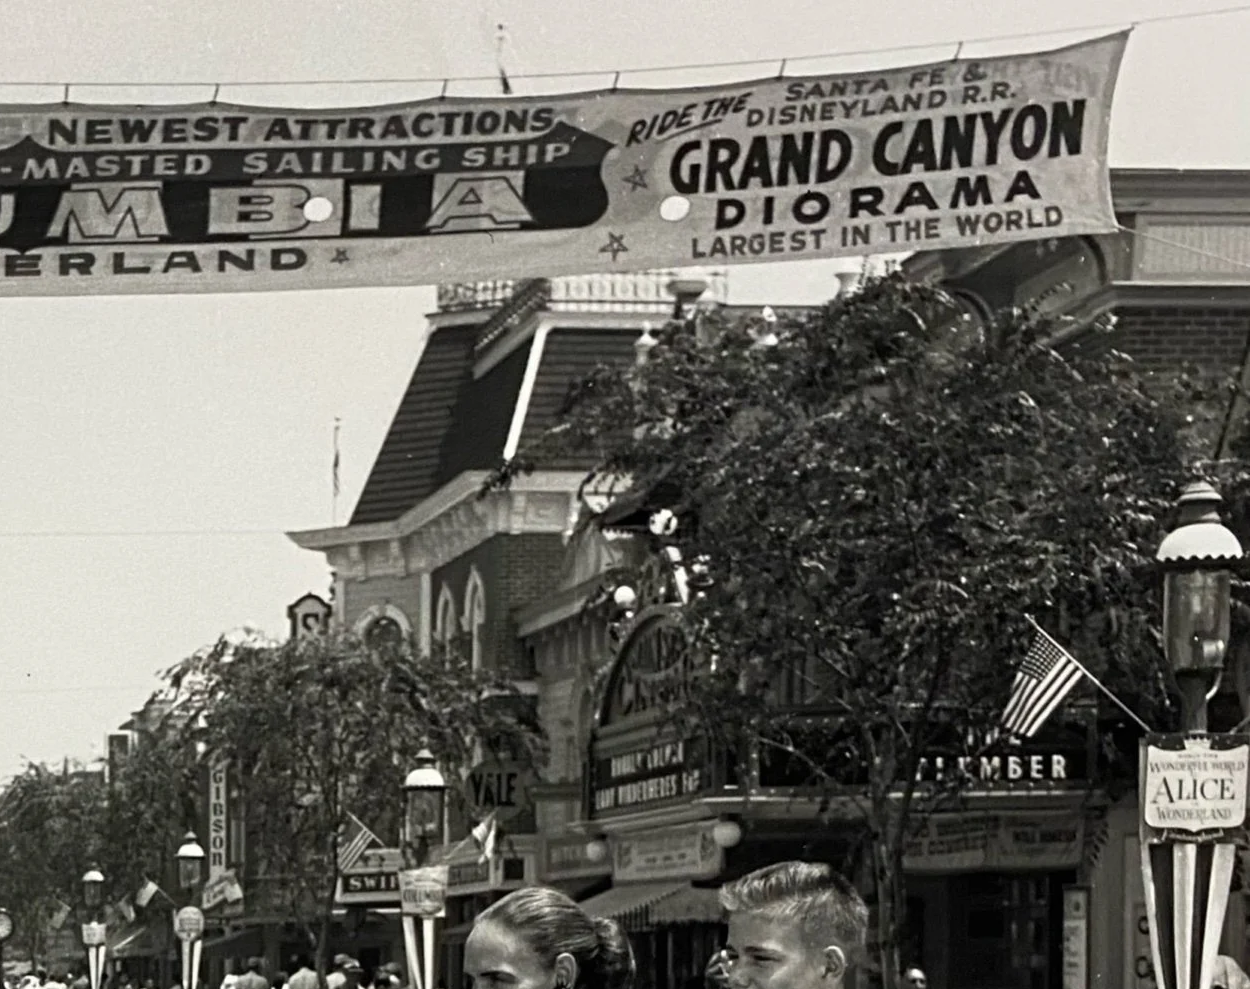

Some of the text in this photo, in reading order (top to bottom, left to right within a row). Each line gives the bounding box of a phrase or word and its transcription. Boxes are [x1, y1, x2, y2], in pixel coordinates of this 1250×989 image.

[785, 64, 988, 102] SANTA FE &
[625, 92, 753, 147] RIDE THE
[747, 81, 1017, 128] DISNEYLAND R.R.
[47, 114, 249, 147] NEWEST
[263, 106, 554, 141] ATTRACTIONS
[670, 99, 1088, 195] GRAND CANYON
[243, 143, 442, 175] SAILING
[461, 141, 572, 166] SHIP
[716, 170, 1042, 231] DIORAMA
[691, 205, 1065, 260] LARGEST IN THE WORLD
[469, 772, 518, 807] YALE
[1150, 777, 1236, 804] ALICE
[1155, 806, 1232, 822] WONDERLAND
